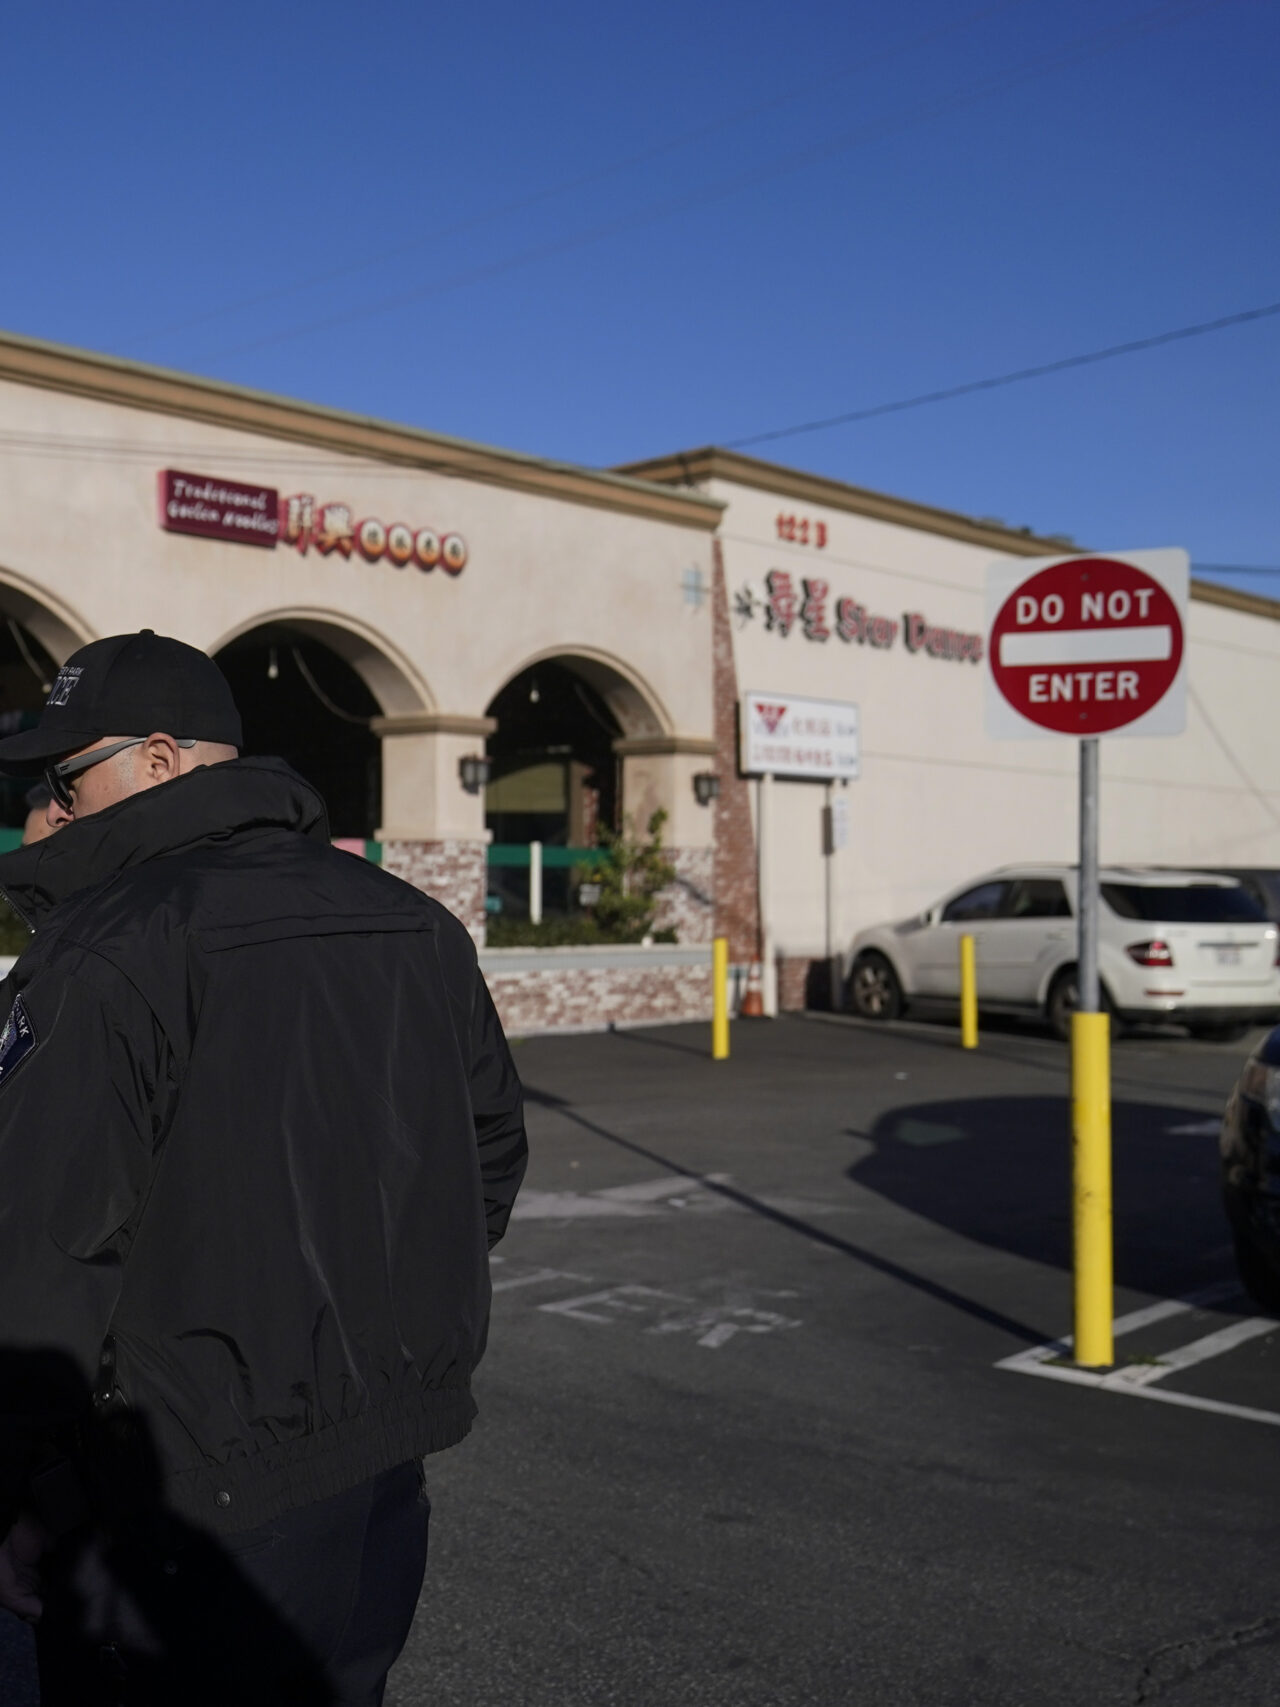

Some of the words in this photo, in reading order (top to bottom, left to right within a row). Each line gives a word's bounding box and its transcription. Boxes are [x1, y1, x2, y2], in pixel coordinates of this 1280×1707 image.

[1015, 593, 1065, 626] DO
[1080, 587, 1156, 622] NOT
[1027, 669, 1140, 704] ENTER
